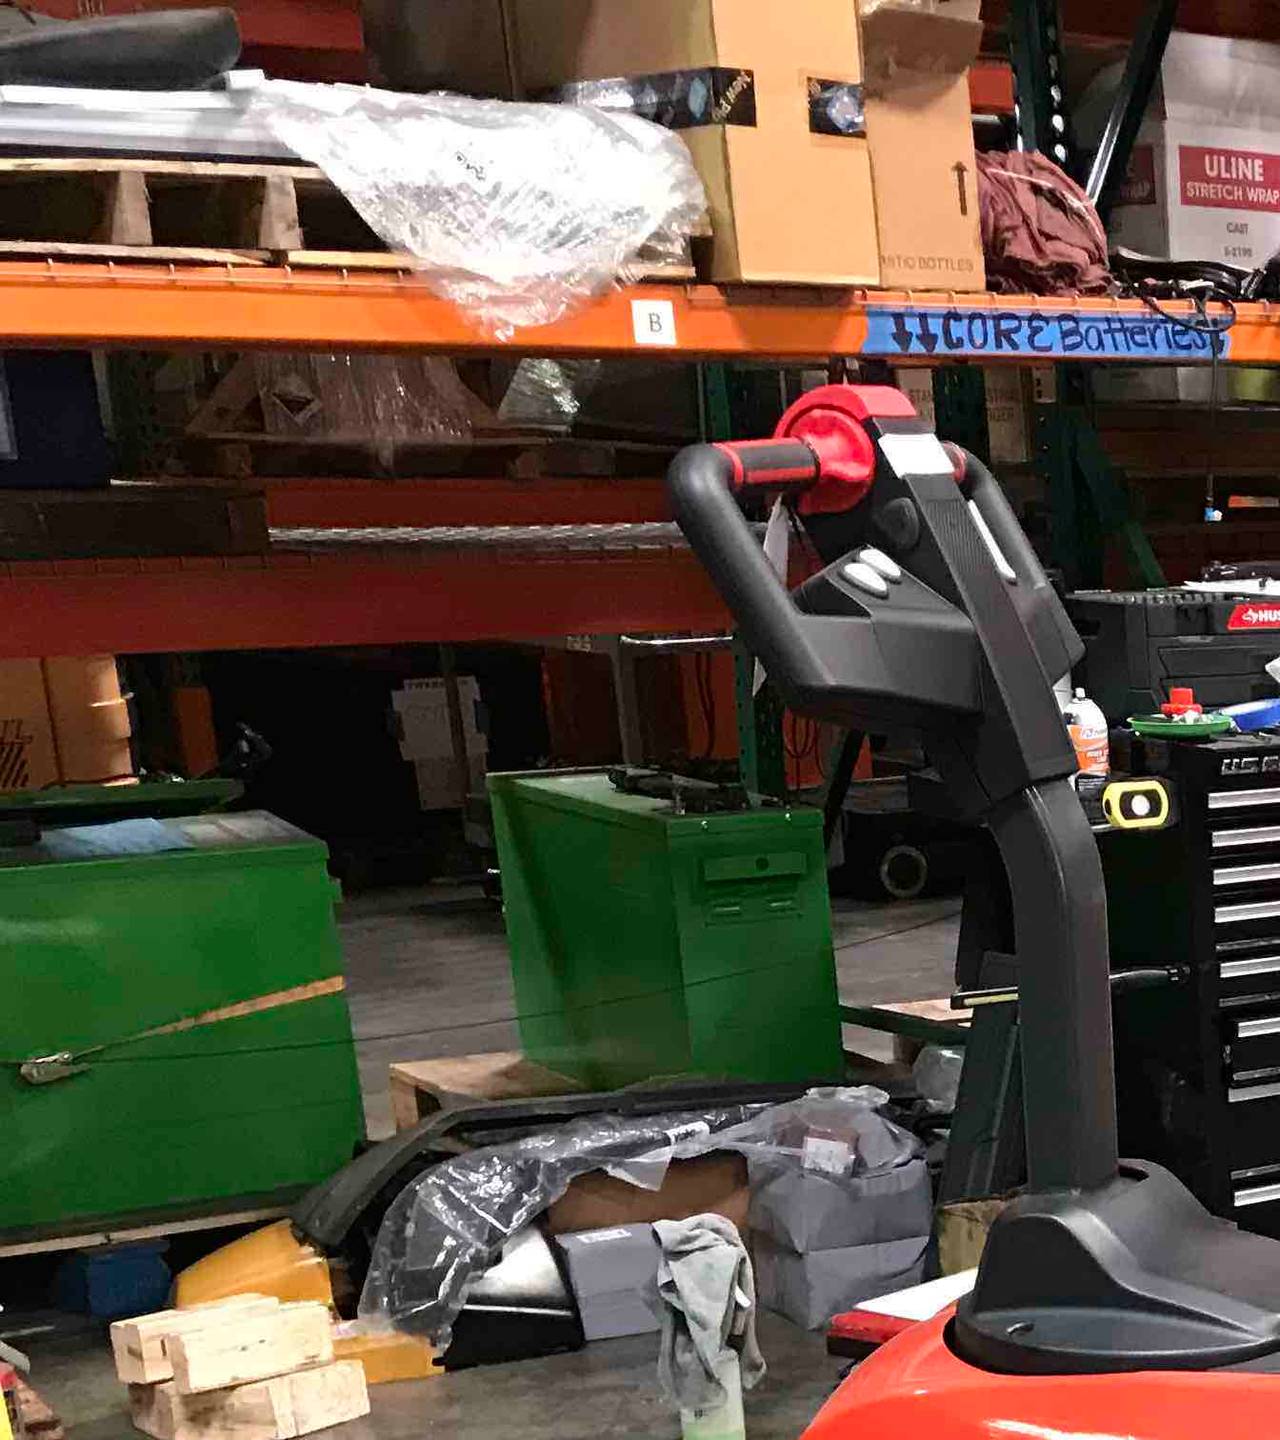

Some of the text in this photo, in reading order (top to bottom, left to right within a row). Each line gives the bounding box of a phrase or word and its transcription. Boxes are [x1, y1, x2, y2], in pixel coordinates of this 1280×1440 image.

[1204, 153, 1265, 182] ULINE
[1186, 181, 1280, 205] STRETCH WRAP
[1226, 221, 1249, 235] CAST
[648, 312, 662, 332] B
[941, 311, 1209, 352] CORE Batteries
